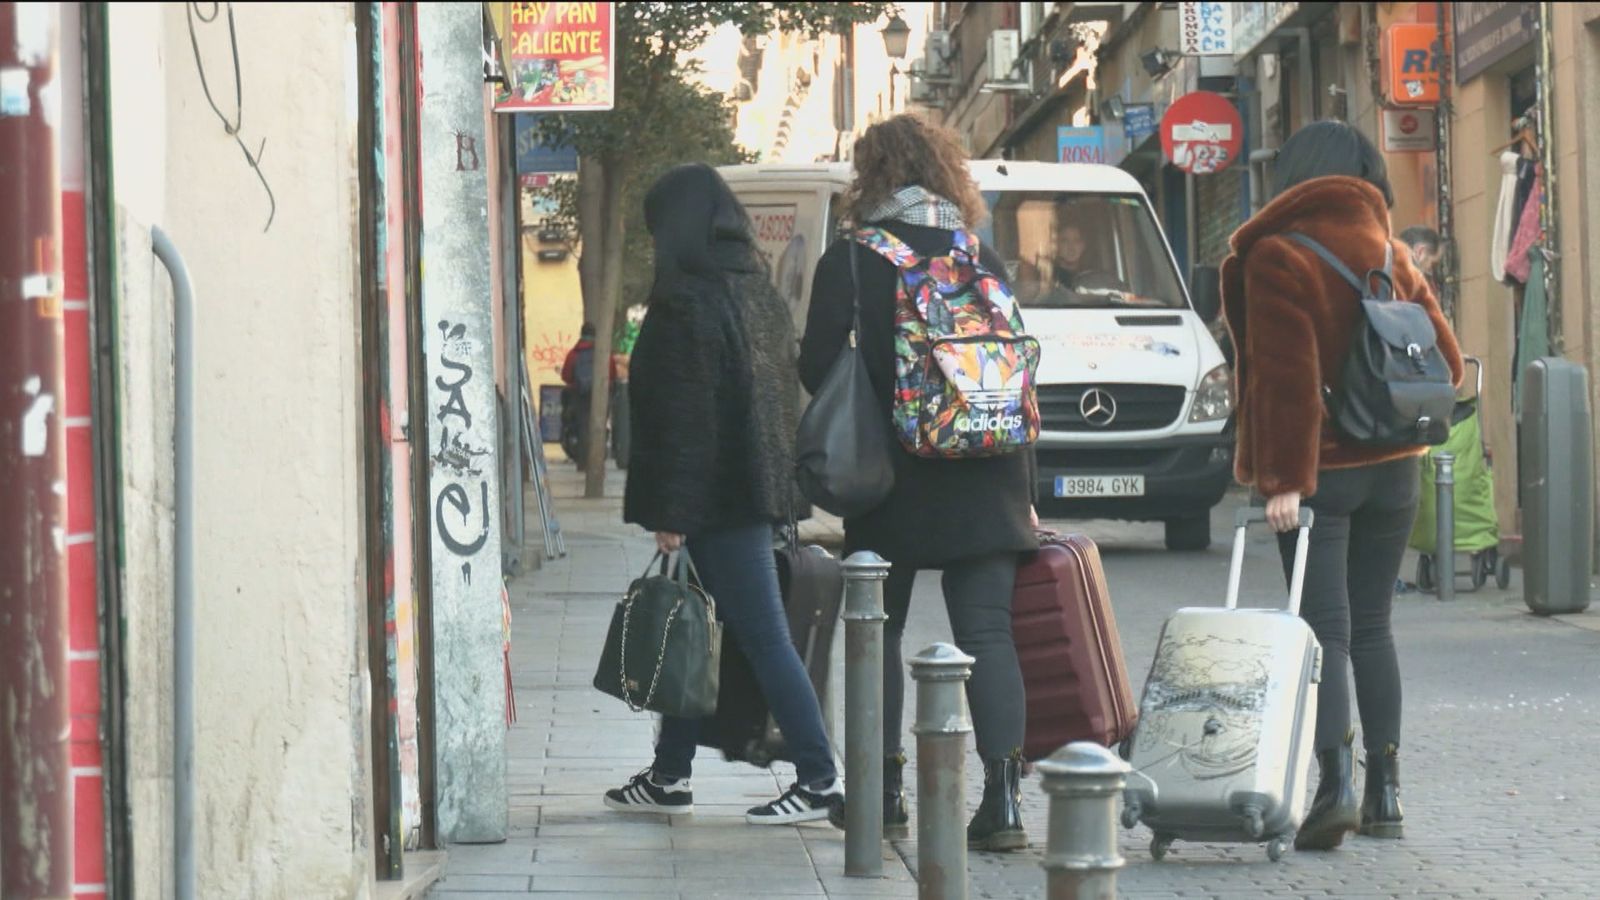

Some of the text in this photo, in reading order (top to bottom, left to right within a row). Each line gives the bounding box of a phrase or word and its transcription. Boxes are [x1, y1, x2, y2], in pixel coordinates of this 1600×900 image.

[556, 2, 597, 24] PAN
[957, 412, 1023, 433] adidas
[1067, 478, 1139, 494] 3984 GYK
